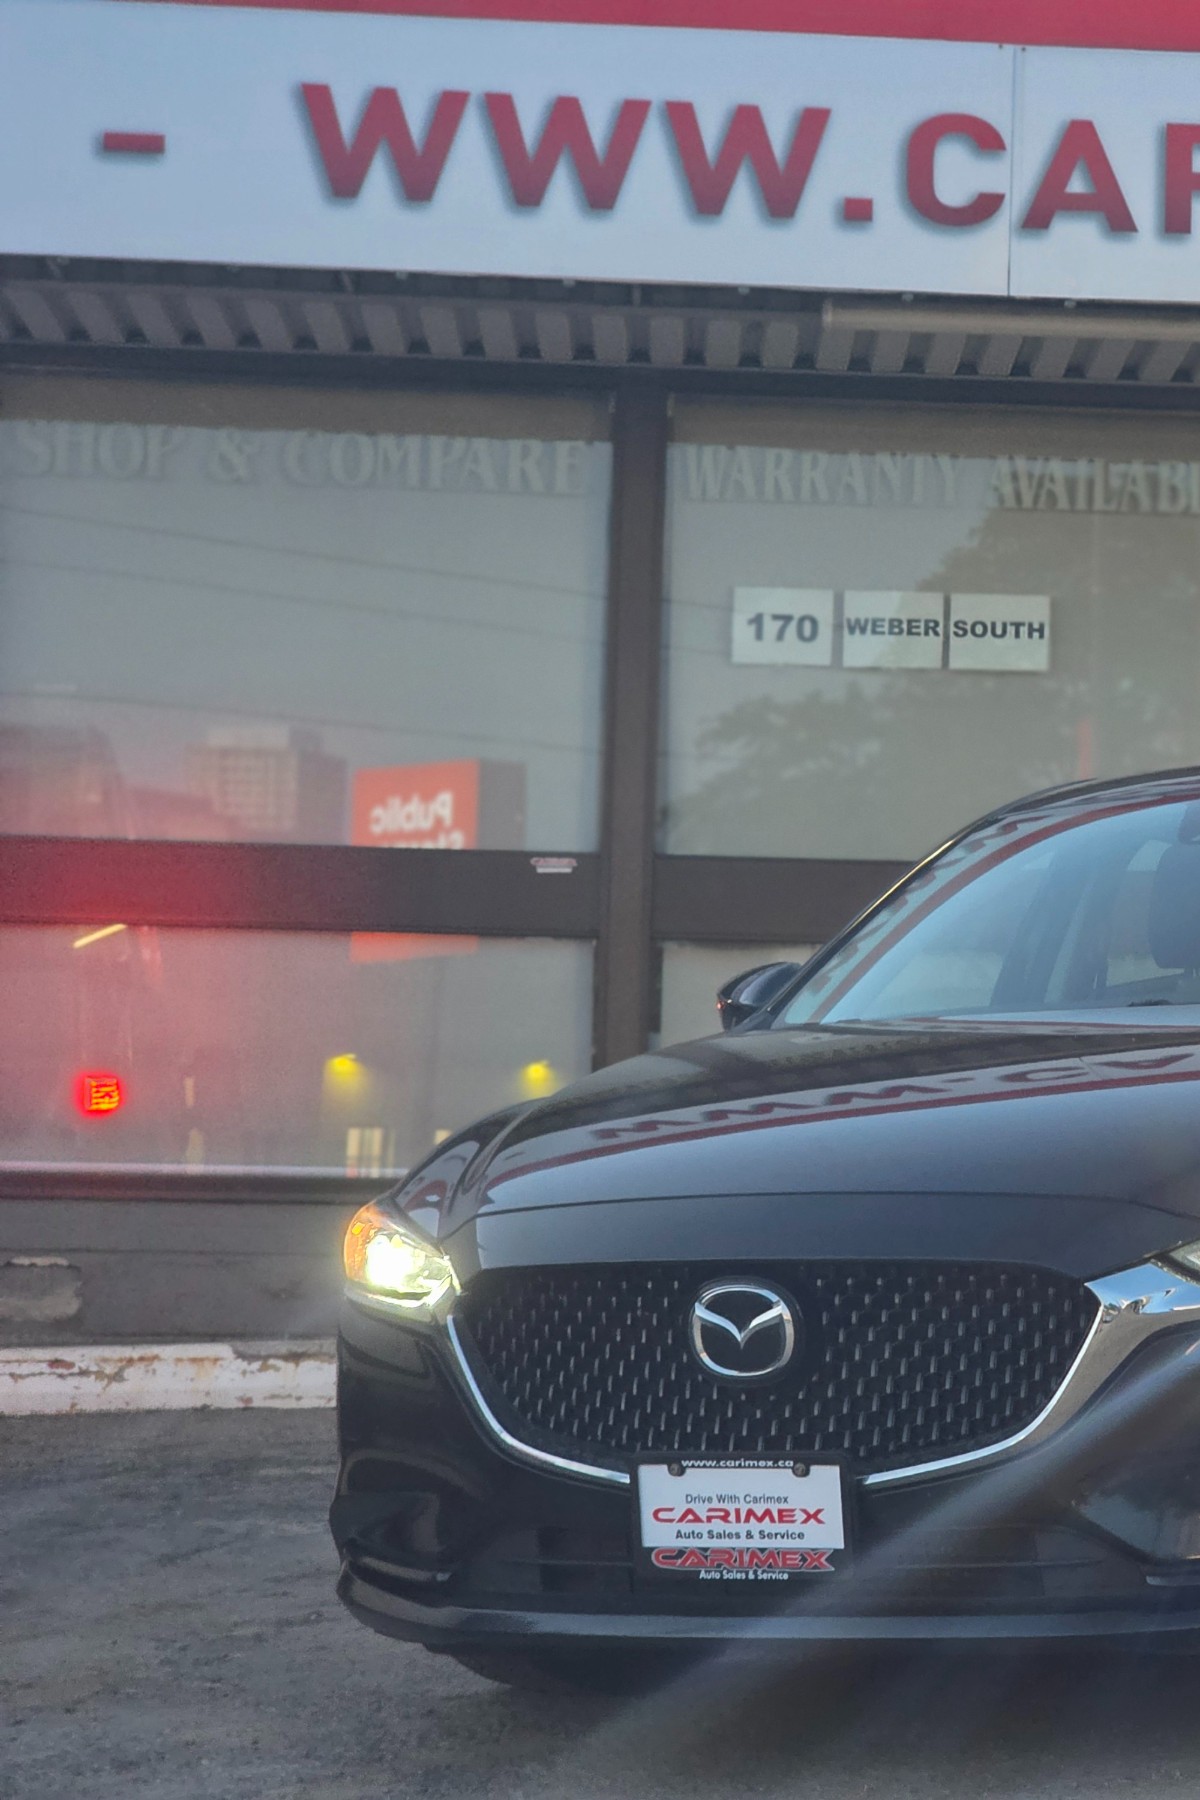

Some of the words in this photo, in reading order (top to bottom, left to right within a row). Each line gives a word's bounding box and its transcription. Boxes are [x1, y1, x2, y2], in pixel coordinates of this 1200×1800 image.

[15, 421, 178, 479] SHOP
[206, 430, 259, 485] &
[284, 434, 588, 495] COMPARE
[685, 444, 964, 505] WARRANTY
[746, 612, 820, 645] 170
[845, 617, 941, 638] WEBER
[952, 619, 1046, 641] SOUTH
[681, 1458, 794, 1468] www.carimex.ca
[685, 1493, 713, 1505] Drive
[716, 1493, 741, 1505] With
[743, 1494, 789, 1505] Carimex
[652, 1507, 826, 1524] CARIMEX
[675, 1529, 704, 1540] Auto
[707, 1529, 742, 1540] Sales
[745, 1529, 754, 1540] &
[758, 1530, 805, 1540] Service
[653, 1548, 832, 1569] CARIMEX
[699, 1570, 721, 1580] Auto
[723, 1570, 746, 1580] Sales
[757, 1571, 789, 1580] Service
